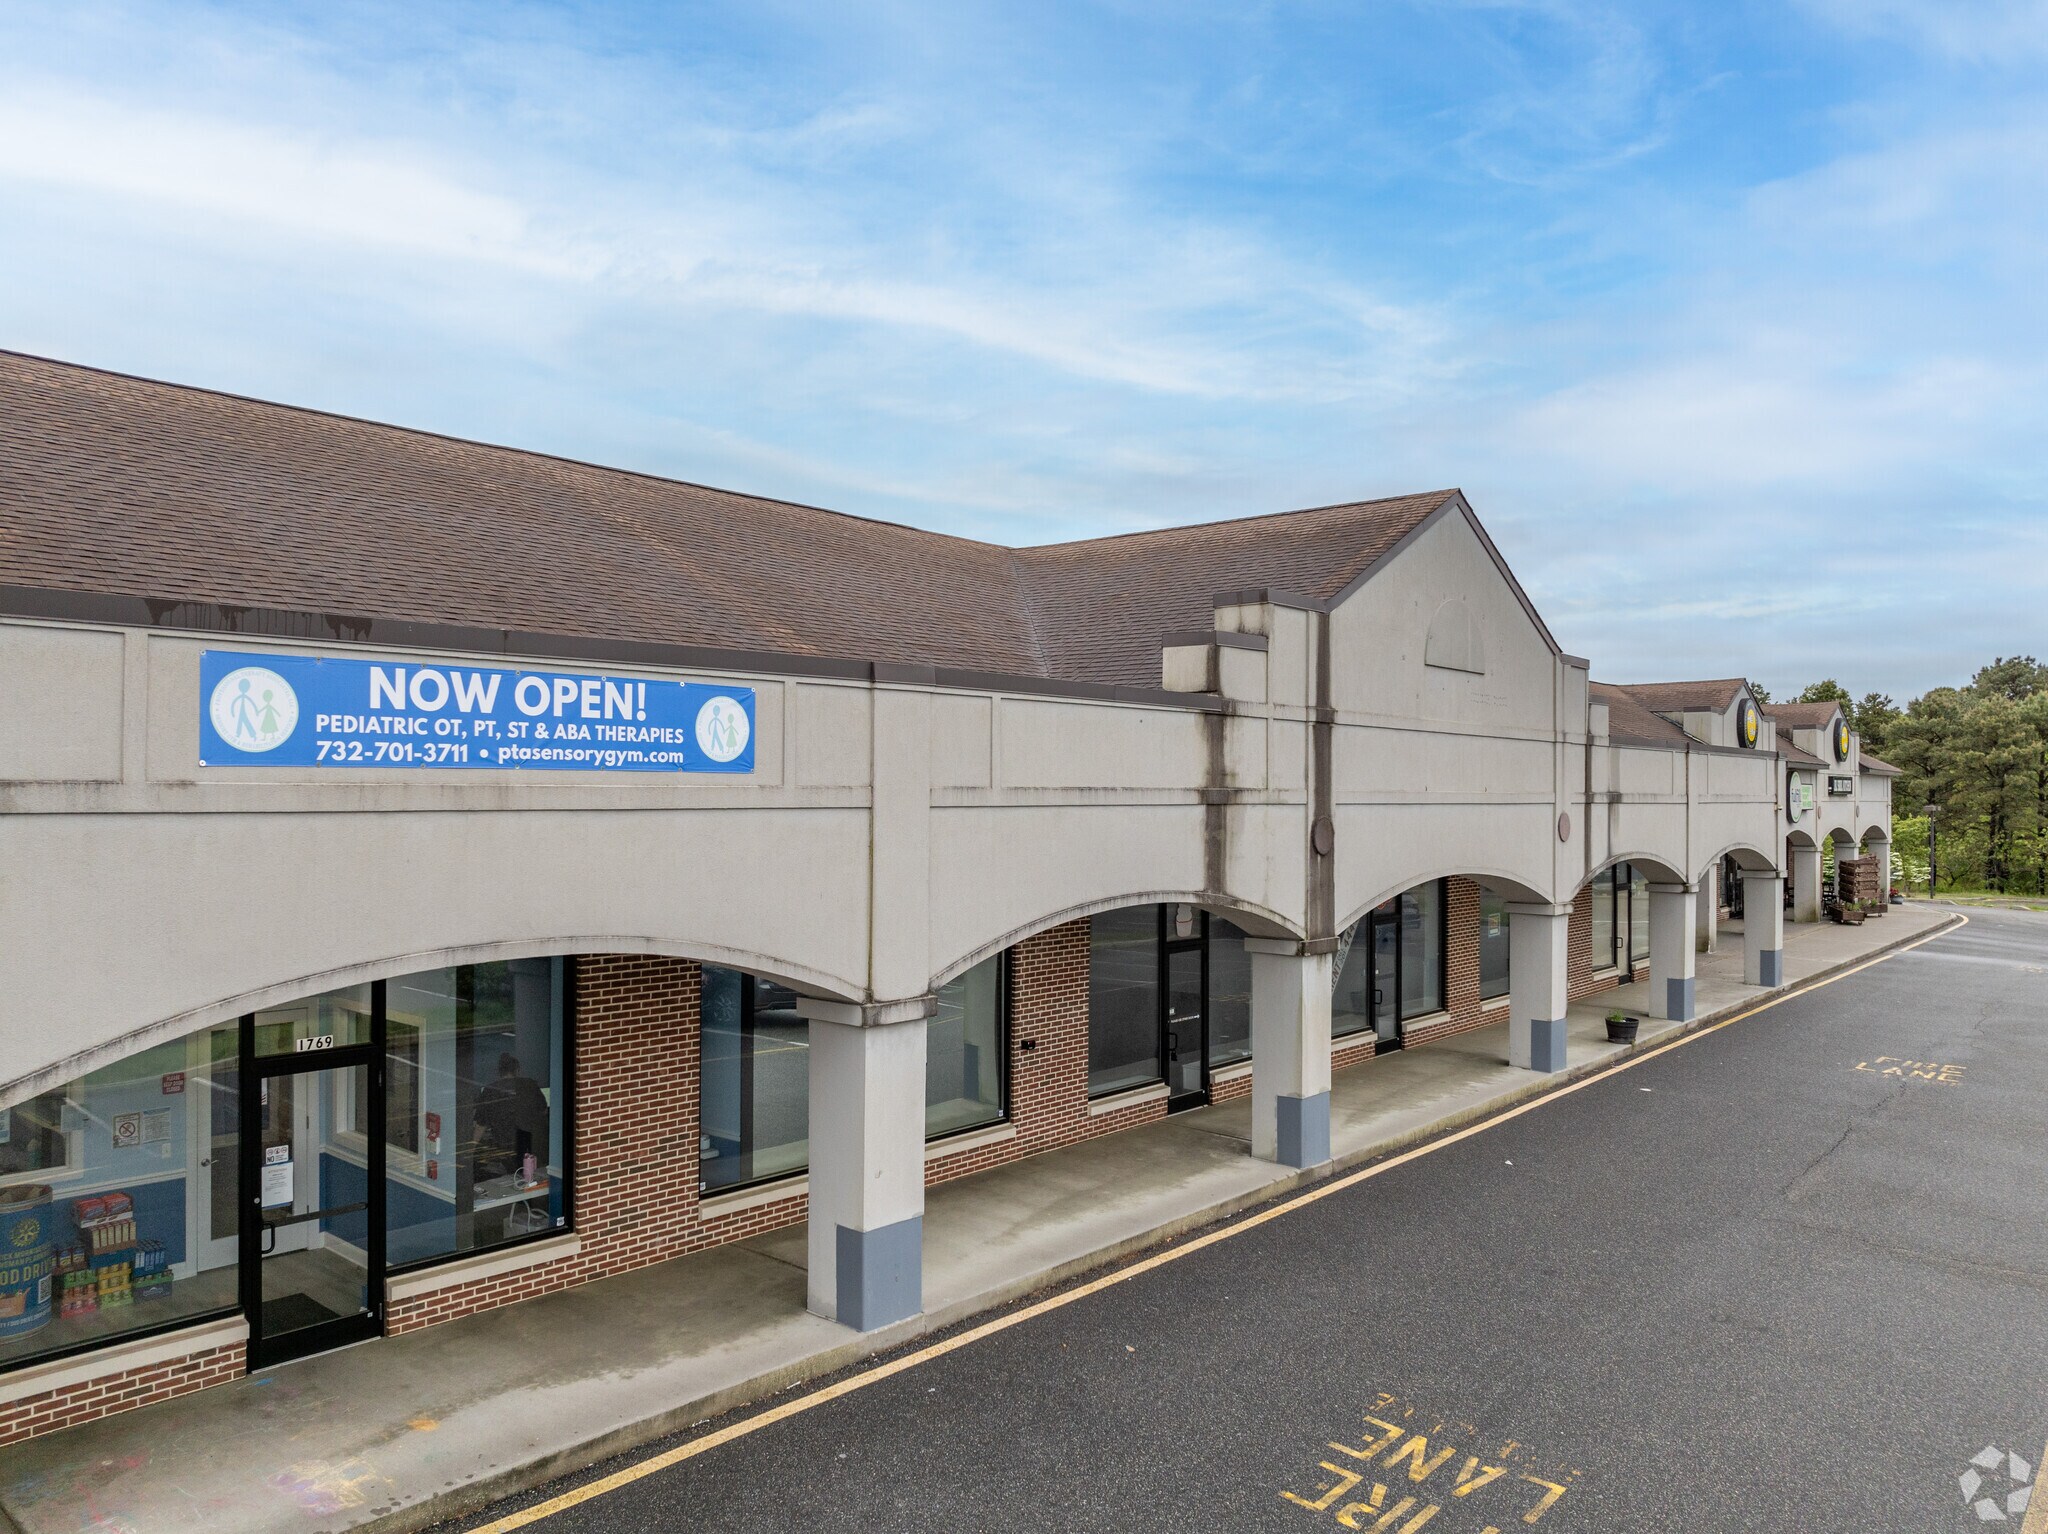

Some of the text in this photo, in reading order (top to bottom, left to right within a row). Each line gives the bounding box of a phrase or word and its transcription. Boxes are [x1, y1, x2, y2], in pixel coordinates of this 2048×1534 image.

[370, 666, 647, 721] NOW OPEN!
[316, 714, 428, 735] PEDIATRIC
[434, 718, 468, 739] OT,
[474, 720, 502, 740] PT,
[507, 721, 529, 739] ST
[534, 722, 549, 739] &
[553, 723, 591, 741] ABA
[595, 725, 684, 744] THERAPIES
[316, 740, 684, 767] 732-701-3711 ptasensorygym.com
[300, 1036, 332, 1051] 1769
[1278, 1460, 1500, 1534] IRE
